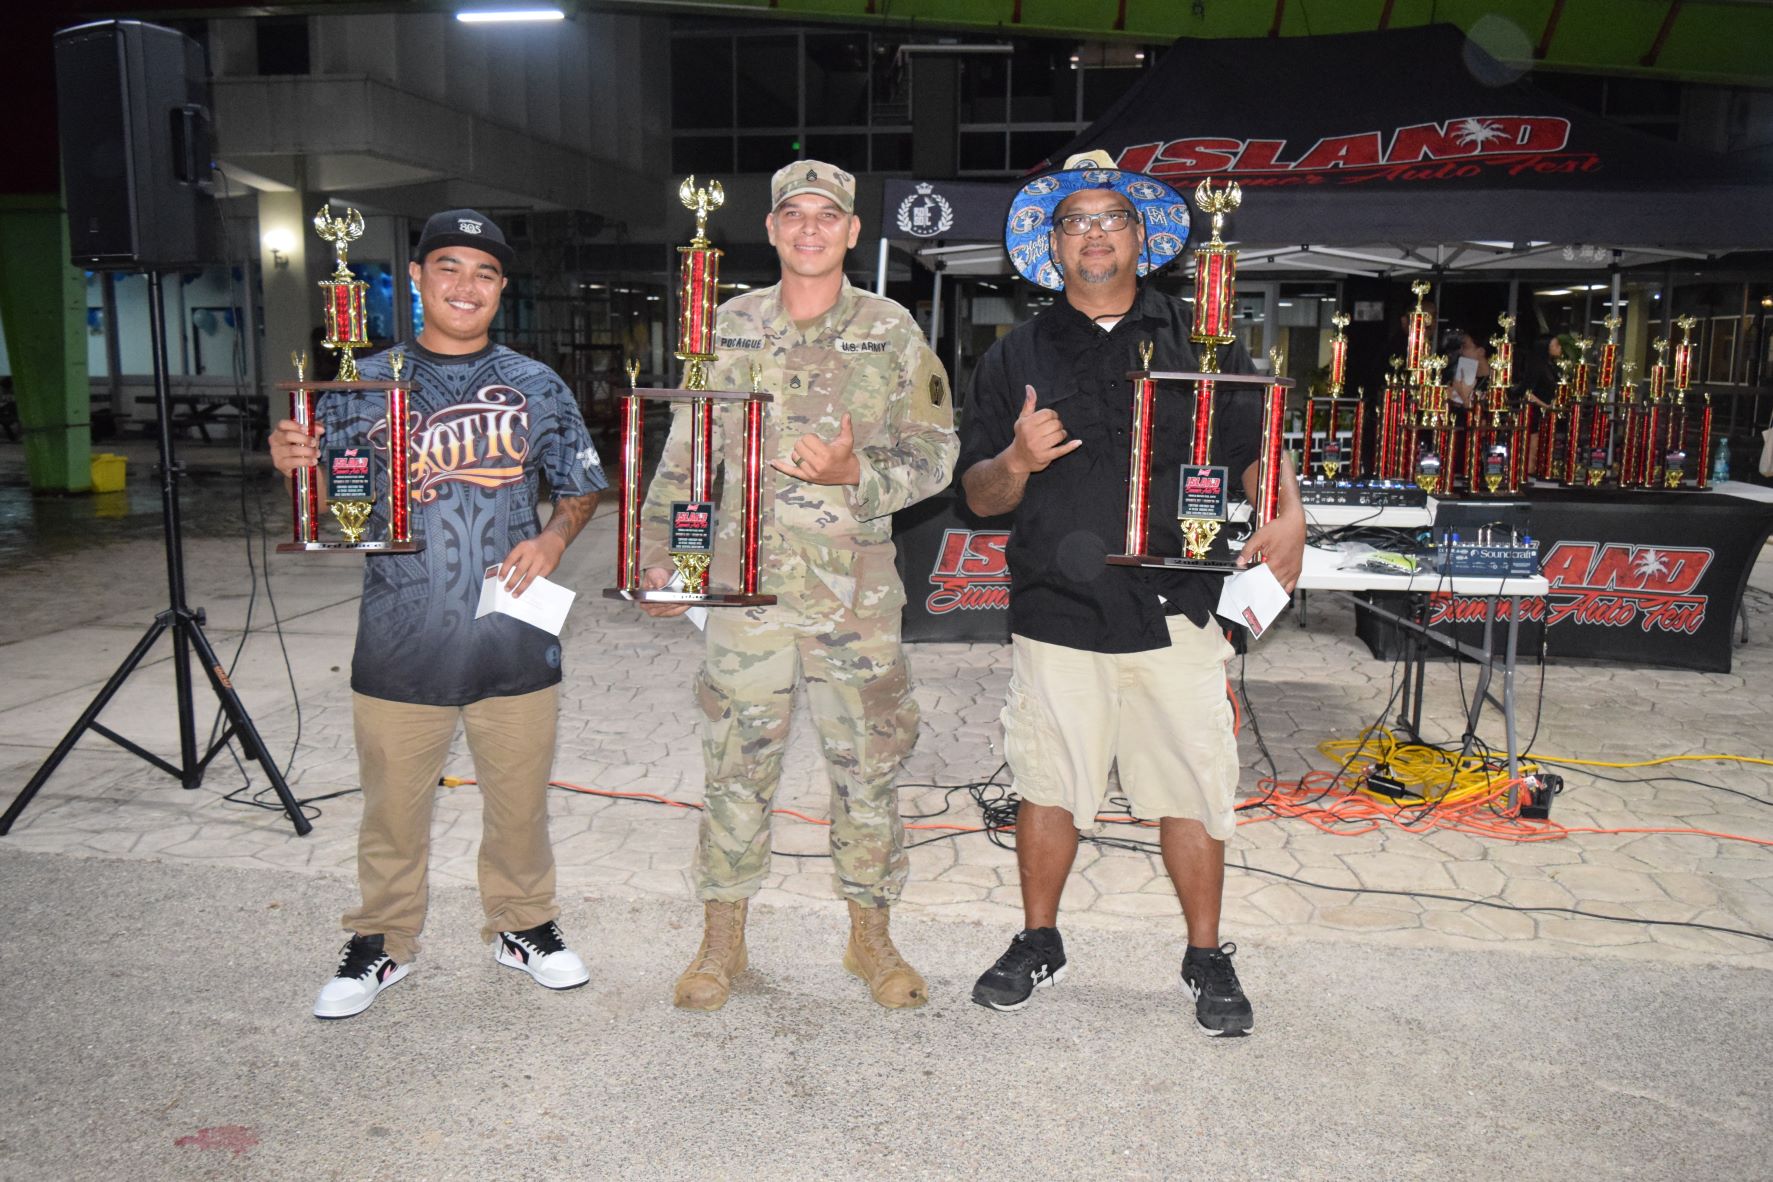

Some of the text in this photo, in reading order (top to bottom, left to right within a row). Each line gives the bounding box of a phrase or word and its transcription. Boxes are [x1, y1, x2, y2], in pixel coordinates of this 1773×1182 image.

[1115, 116, 1571, 175] ISLAND
[861, 341, 887, 352] ARMY
[930, 529, 1012, 576] IS
[1536, 541, 1715, 595] AND
[1546, 590, 1636, 626] Auto
[1636, 597, 1708, 635] Fest
